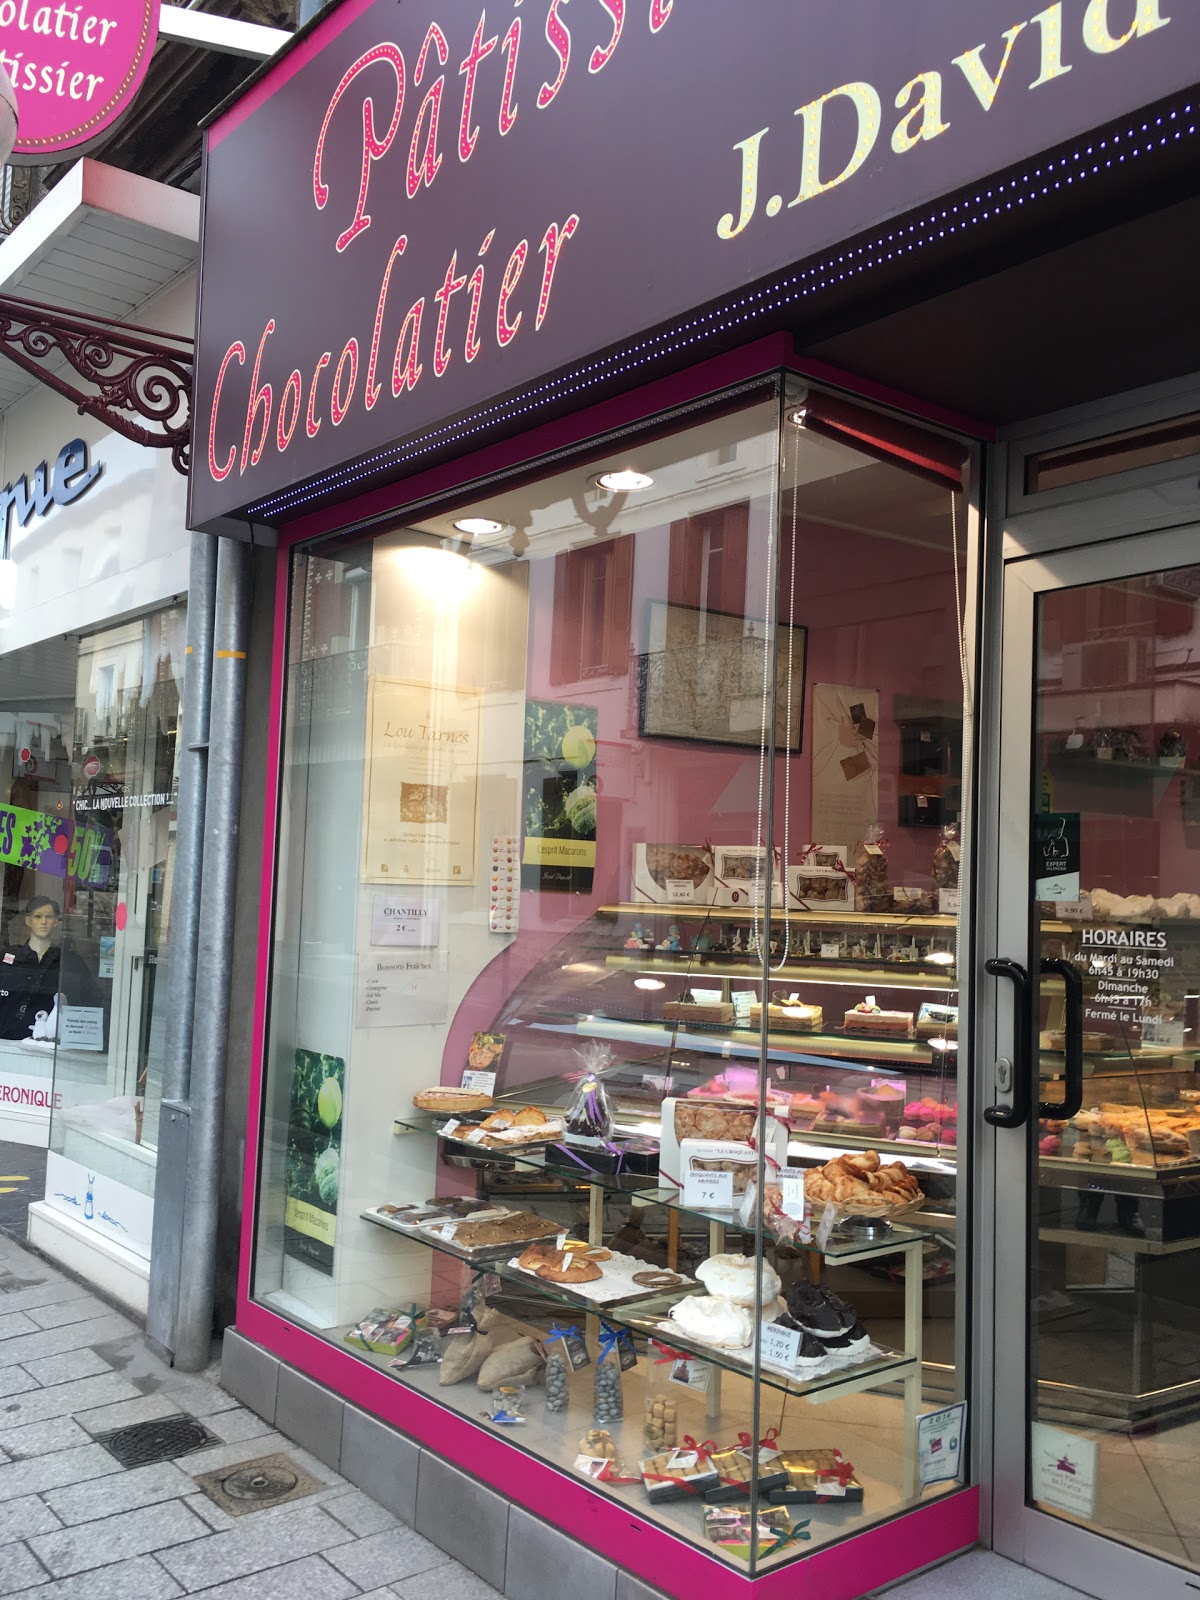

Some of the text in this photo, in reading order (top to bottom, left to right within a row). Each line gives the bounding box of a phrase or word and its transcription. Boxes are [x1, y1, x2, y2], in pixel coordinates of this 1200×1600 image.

[208, 213, 580, 483] Chocolatier
[383, 721, 414, 739] Lou
[100, 796, 129, 811] NOUVELLE
[129, 792, 165, 807] COLLECTION
[558, 845, 587, 857] Macarons
[383, 907, 429, 917] CHANTILLY
[396, 924, 407, 932] 2 €
[1082, 928, 1167, 948] HORAIRES
[1074, 951, 1175, 968] du Mardi au Samedi
[1088, 965, 1159, 980] 6h45 à 19h30
[1098, 980, 1149, 994] Dimanche
[1094, 993, 1120, 1005] 6h45
[1134, 995, 1152, 1007] 17h
[1085, 1008, 1162, 1025] Fermé le Lundi
[701, 1191, 707, 1199] 7
[770, 1338, 785, 1349] 1,20
